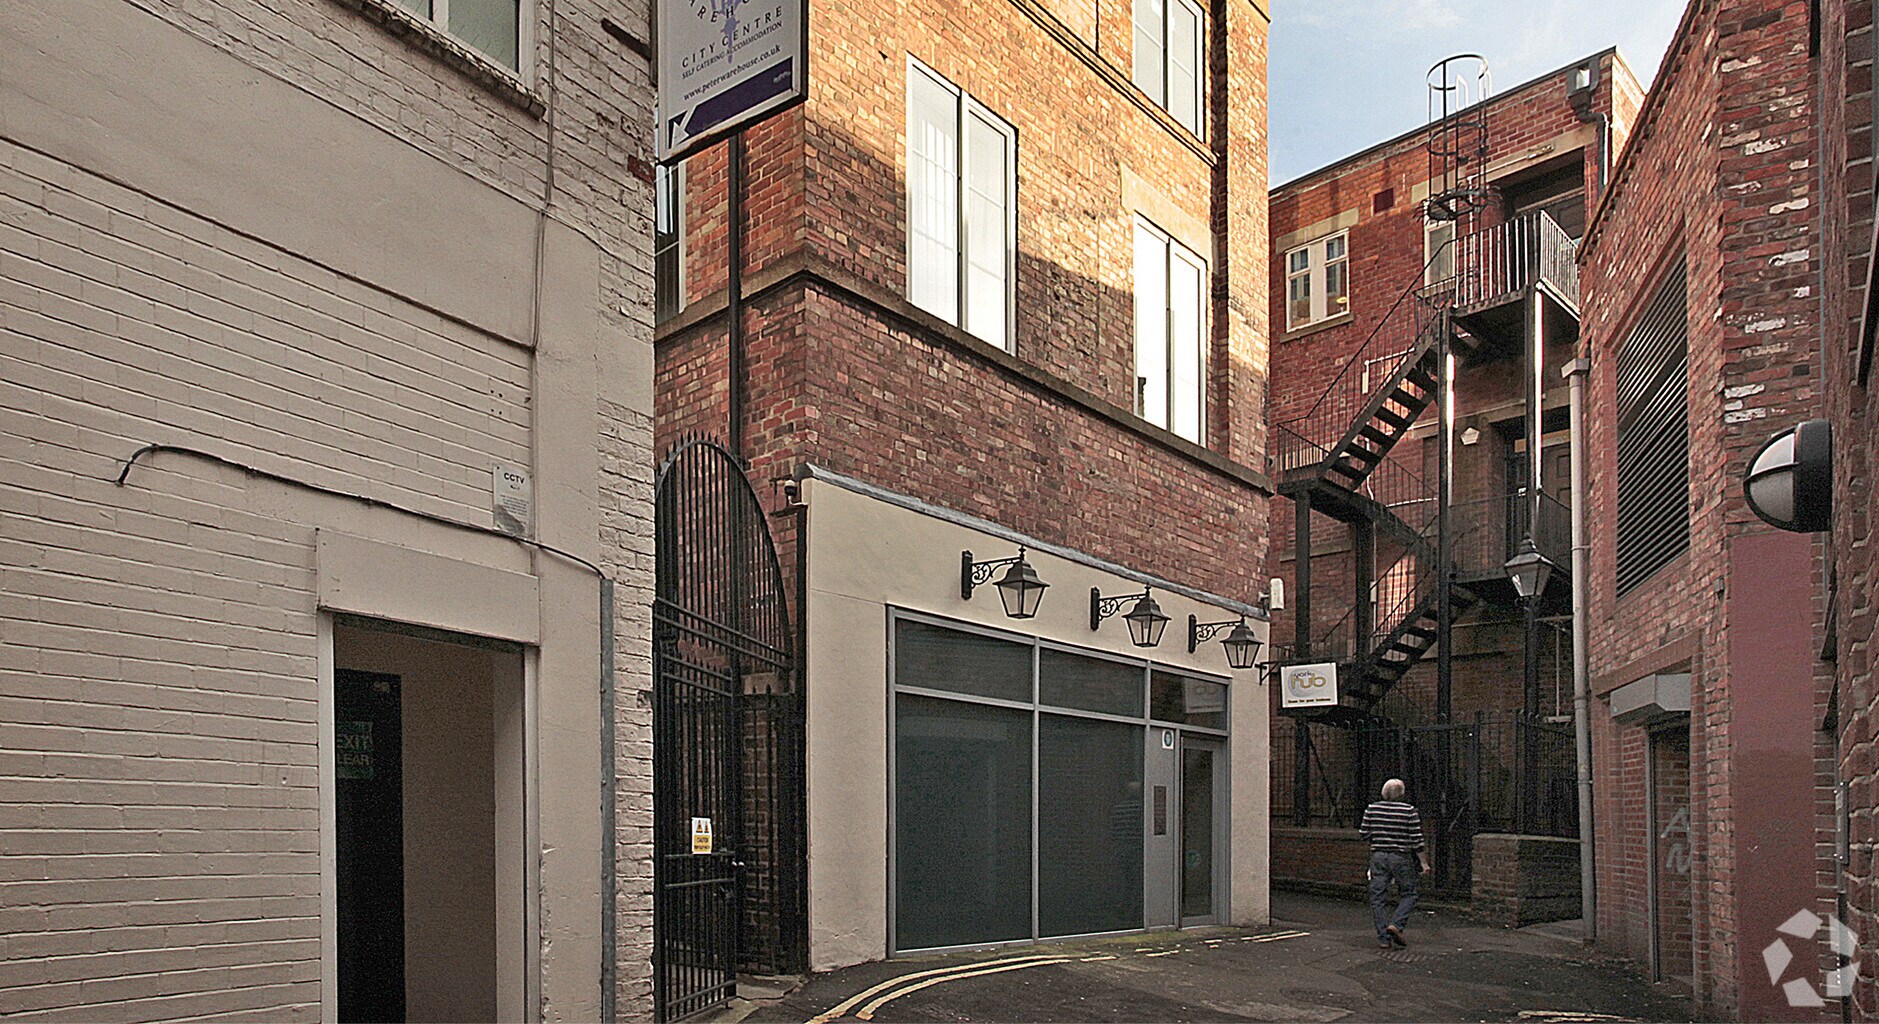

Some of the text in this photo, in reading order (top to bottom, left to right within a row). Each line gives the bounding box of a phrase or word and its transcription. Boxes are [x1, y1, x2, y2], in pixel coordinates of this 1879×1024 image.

[681, 5, 783, 69] CITY CENTRE
[681, 20, 783, 80] SELF CATERING ACCOMMODATION
[683, 44, 781, 101] www.peterwarehouse.co.uk
[503, 472, 525, 484] CCTV
